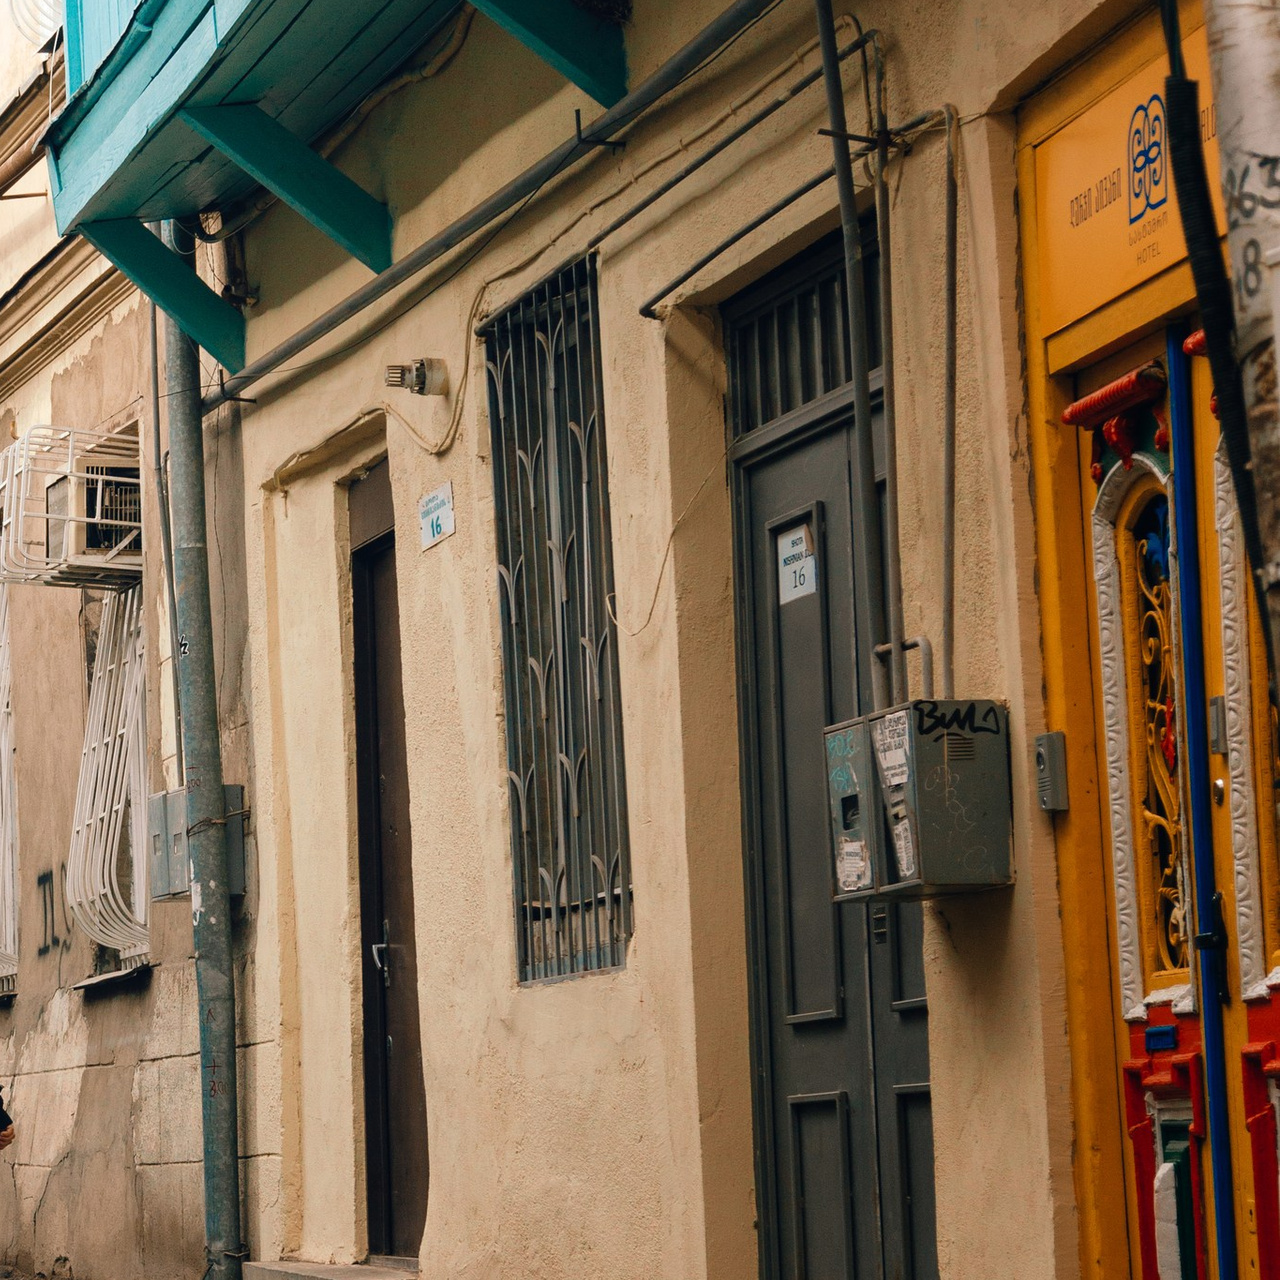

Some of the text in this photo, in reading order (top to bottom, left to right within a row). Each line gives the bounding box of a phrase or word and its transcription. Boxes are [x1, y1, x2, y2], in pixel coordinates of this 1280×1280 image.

[1136, 241, 1161, 266] HOTEL
[431, 515, 442, 538] 16
[793, 565, 806, 589] 16
